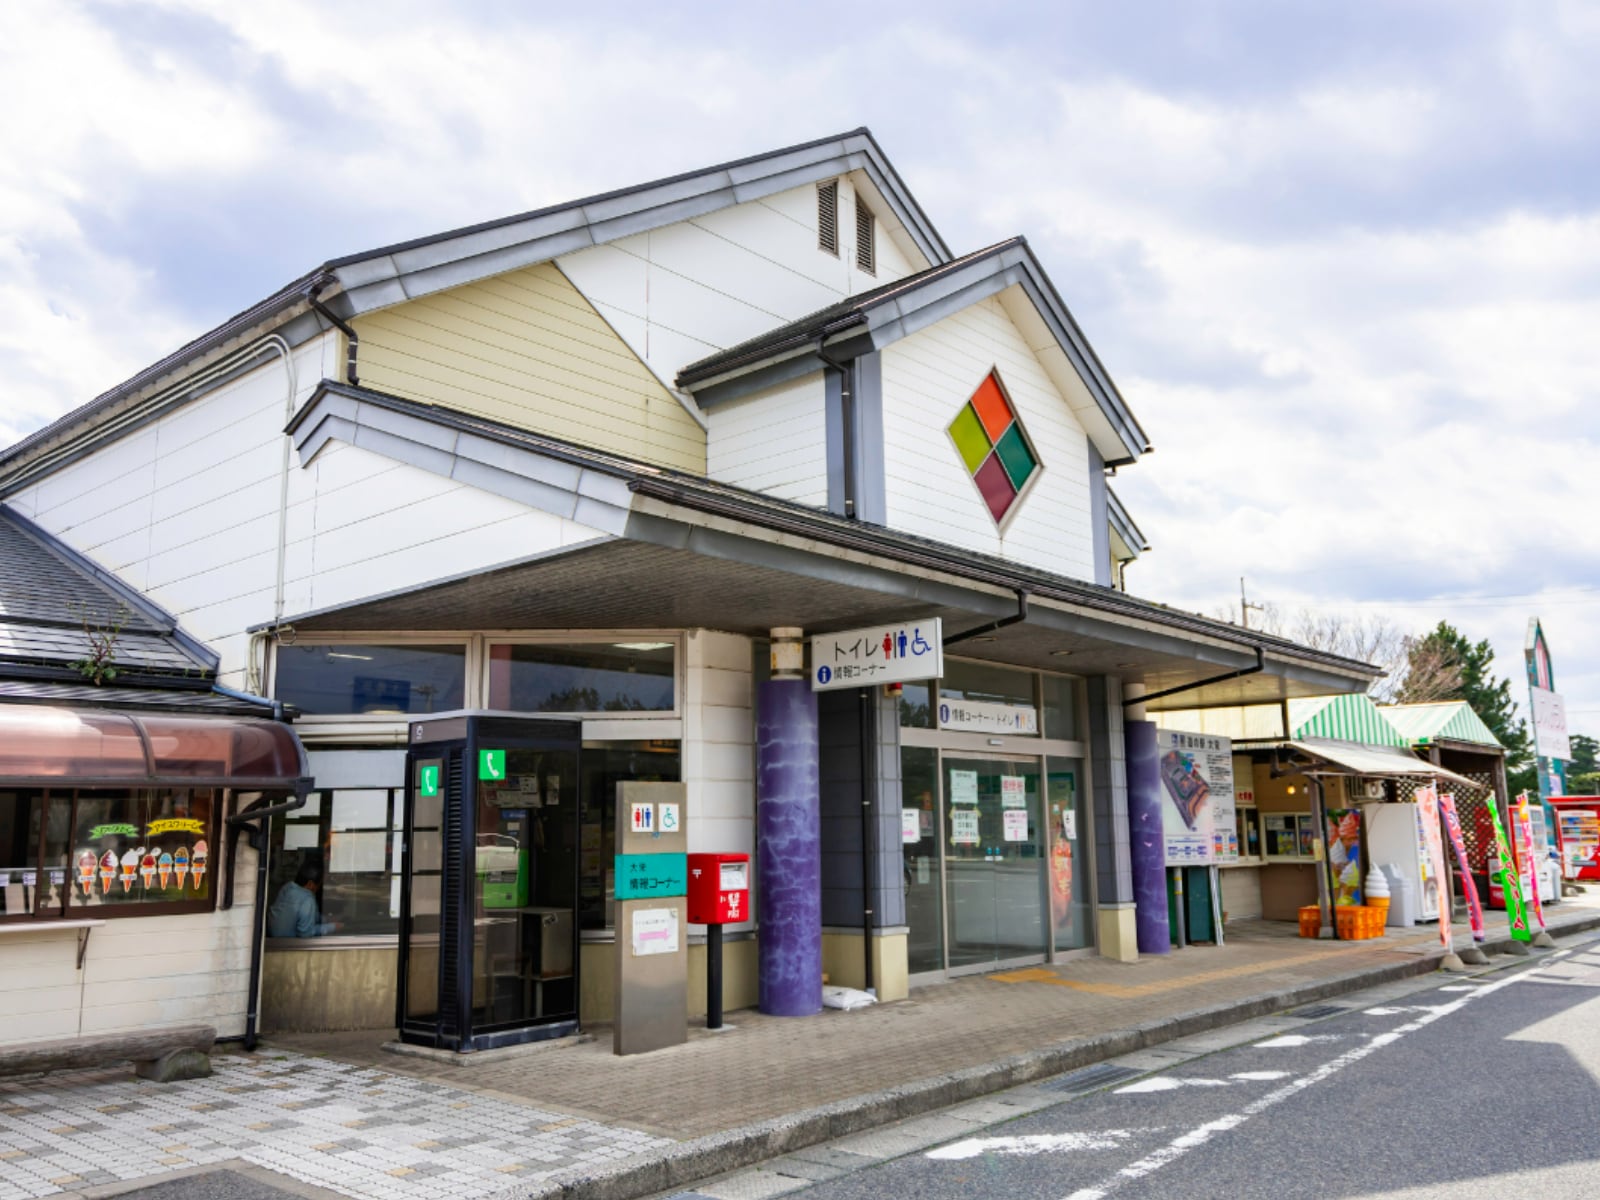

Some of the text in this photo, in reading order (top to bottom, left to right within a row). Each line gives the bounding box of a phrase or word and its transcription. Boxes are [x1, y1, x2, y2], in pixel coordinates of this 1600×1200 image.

[835, 637, 878, 661] トイレ
[833, 664, 887, 680] 情報コーナー
[630, 877, 681, 890] 情報コーナー
